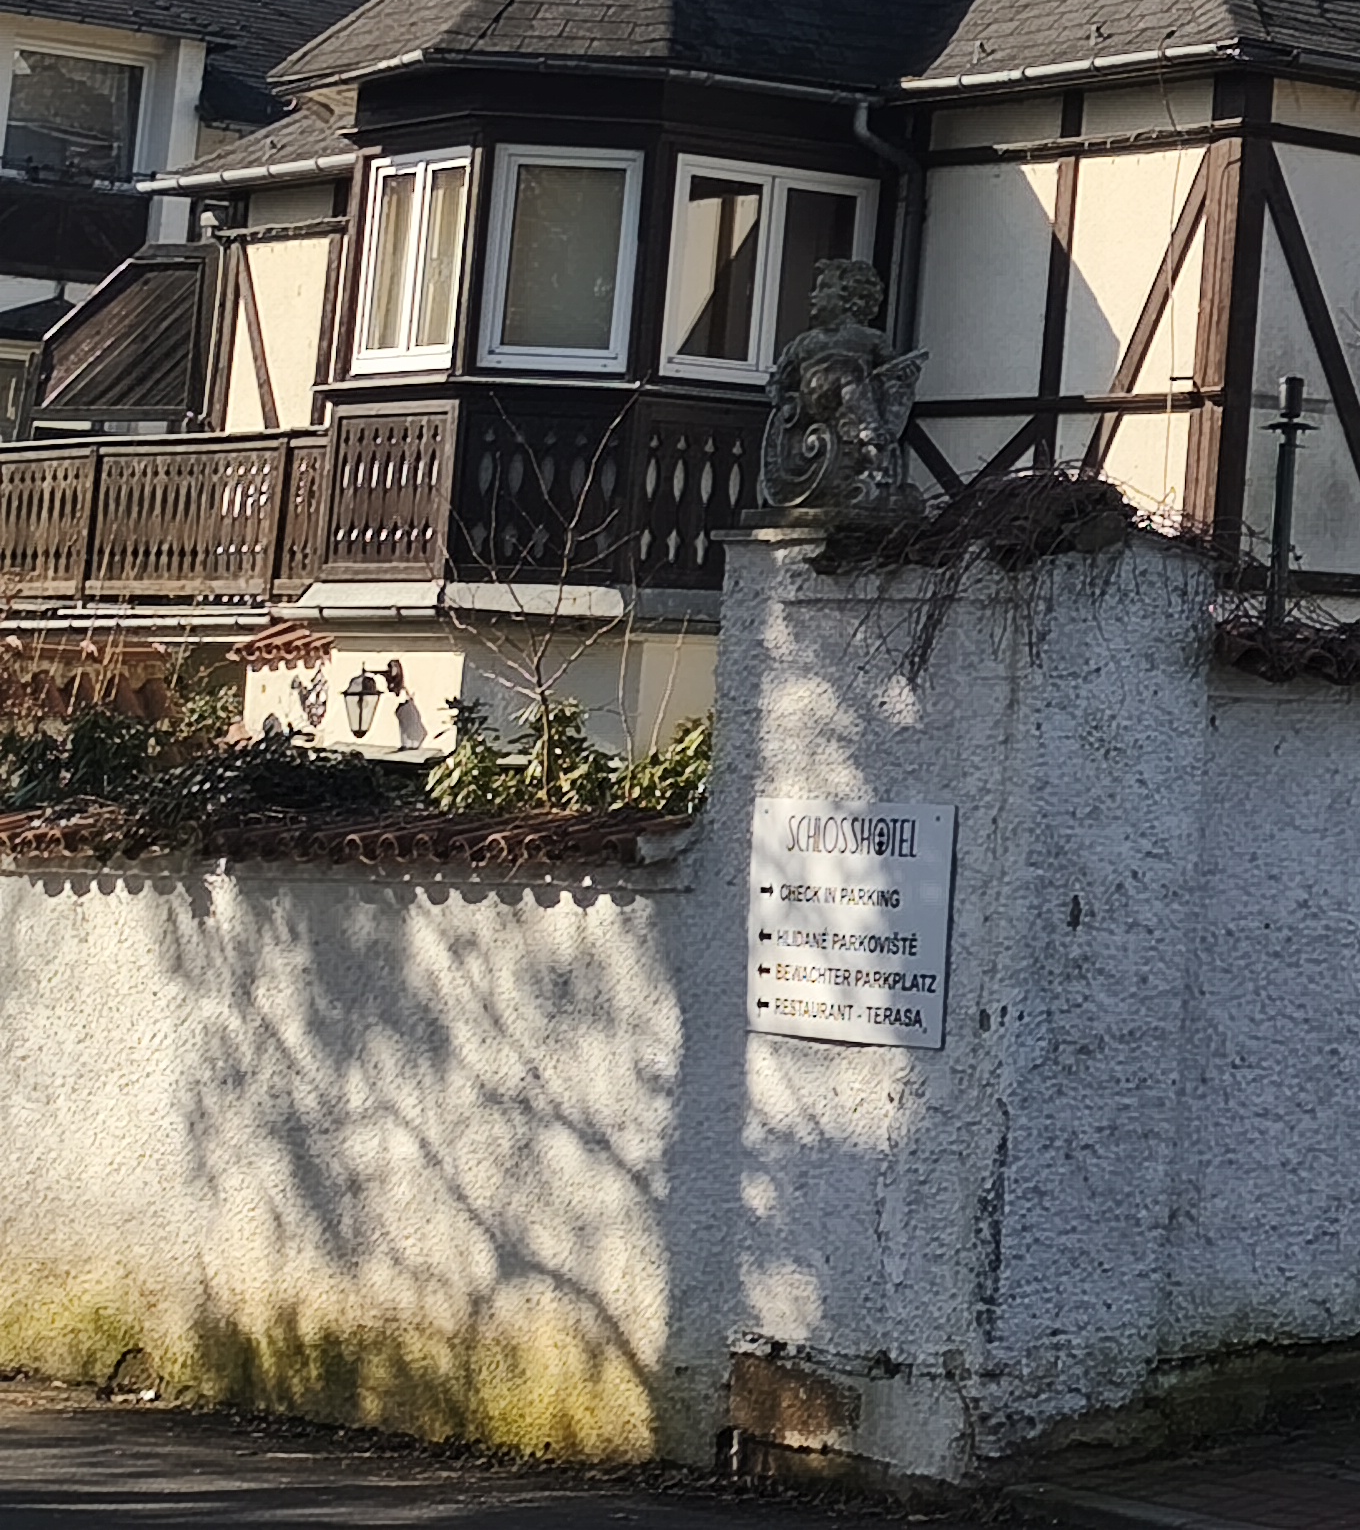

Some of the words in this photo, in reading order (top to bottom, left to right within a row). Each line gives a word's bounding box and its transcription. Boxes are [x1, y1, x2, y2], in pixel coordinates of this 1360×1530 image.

[787, 815, 917, 858] SCHLOSSHOTEL
[780, 884, 821, 904] CHECK
[824, 886, 837, 904] IN
[840, 887, 900, 908] PARKING
[832, 931, 918, 956] PARKOVIŠTĚ
[775, 963, 851, 987] BEWACHTER
[855, 970, 937, 993] PARKPLATZ
[774, 998, 853, 1021] RESTAURANT
[866, 1006, 922, 1028] TERASA
